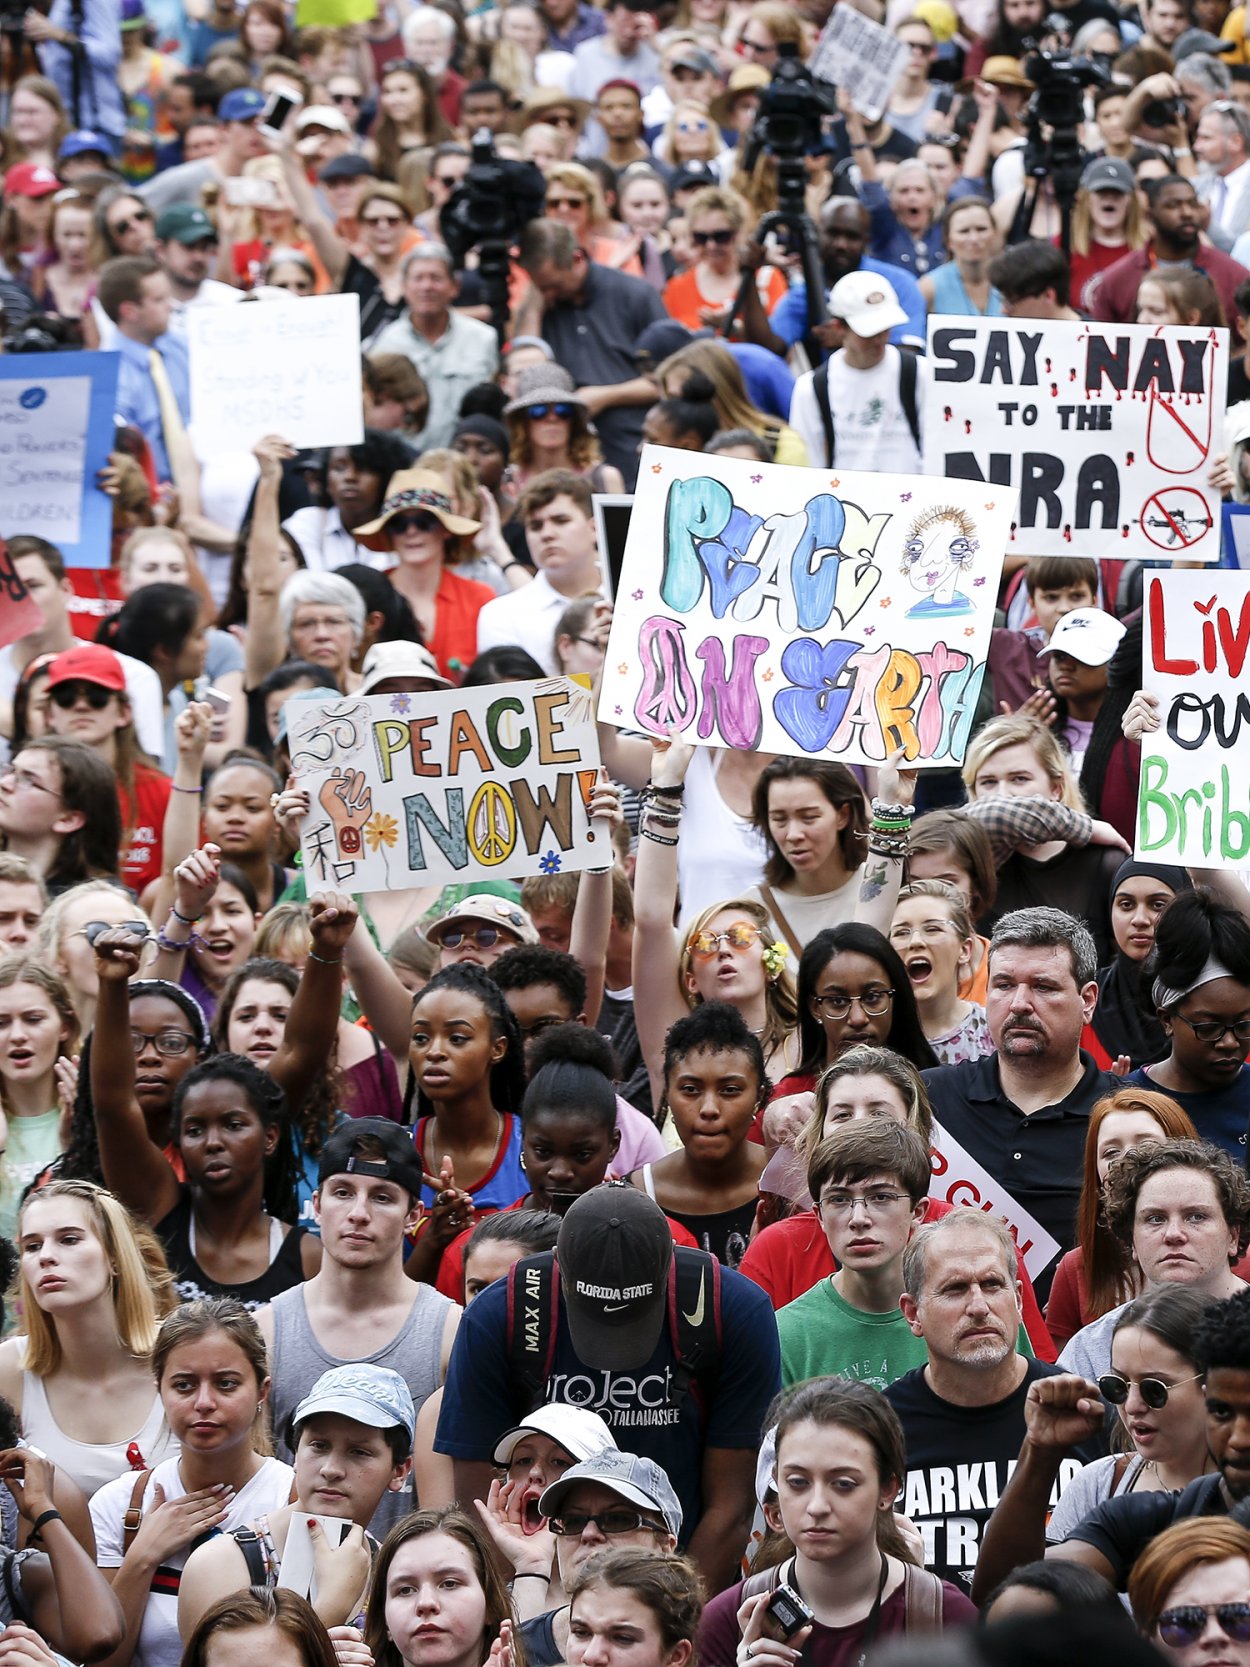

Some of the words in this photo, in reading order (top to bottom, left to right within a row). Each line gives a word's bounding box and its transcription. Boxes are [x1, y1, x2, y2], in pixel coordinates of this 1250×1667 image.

[932, 328, 1044, 385] SAY
[1085, 334, 1209, 394] NAY
[997, 402, 1038, 426] TO
[1057, 405, 1112, 430] THE
[660, 476, 893, 632] PEACE
[633, 615, 770, 750] ON
[773, 637, 987, 761] EARTH
[372, 691, 582, 783] PEACE
[402, 769, 598, 871] NOW!
[525, 1268, 541, 1299] AIR
[576, 1280, 621, 1301] FLORIDA
[622, 1283, 653, 1300] STATE
[525, 1306, 540, 1352] MAX
[880, 1359, 888, 1373] A
[613, 1407, 680, 1427] TALLAHASSEE
